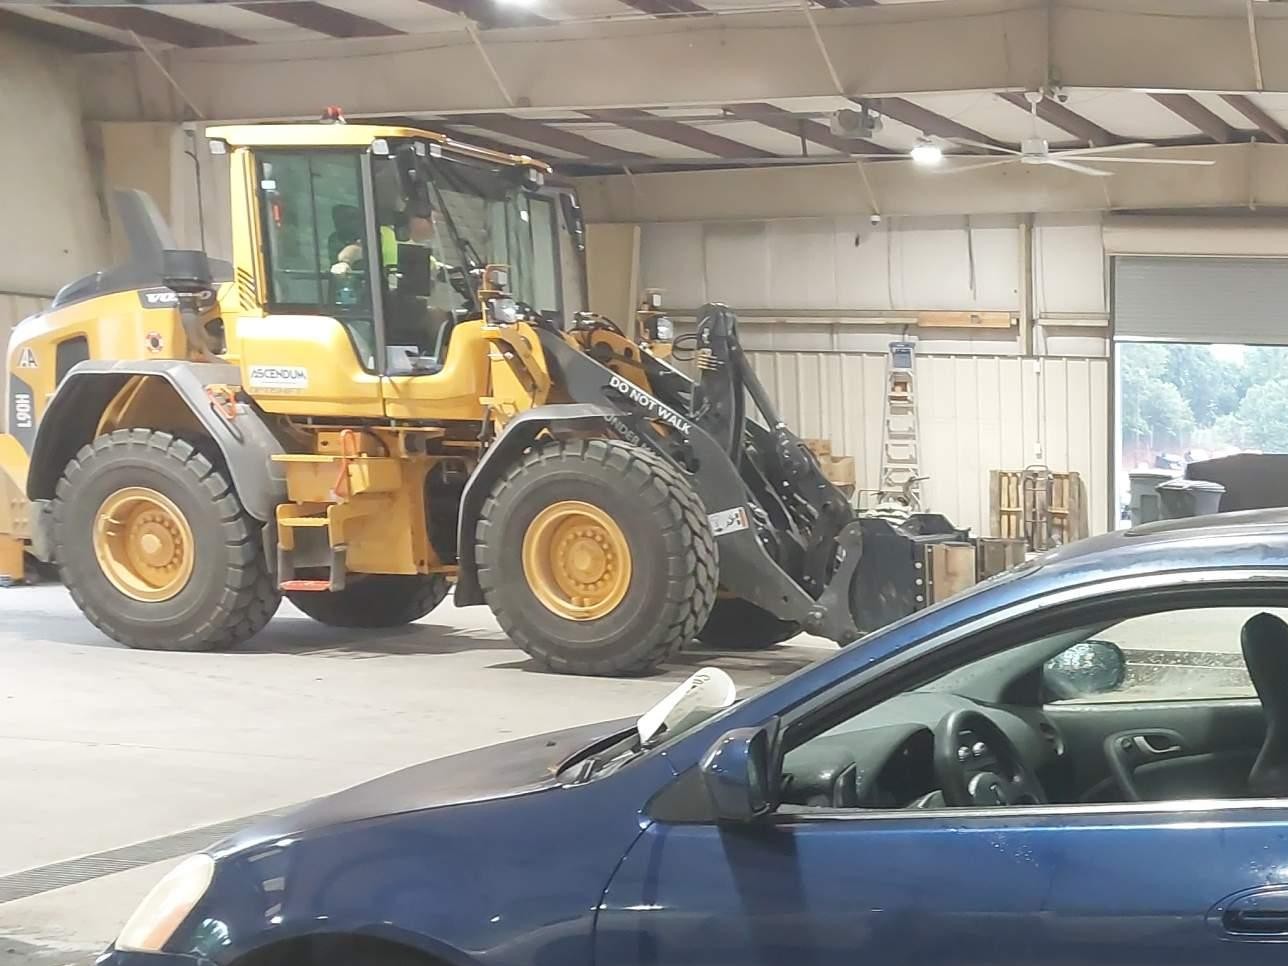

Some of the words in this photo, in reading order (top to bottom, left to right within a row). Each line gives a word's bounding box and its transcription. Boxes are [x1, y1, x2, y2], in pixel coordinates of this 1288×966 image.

[251, 367, 306, 380] ASCENDUM
[15, 393, 32, 428] L90H
[609, 376, 629, 393] DO
[629, 389, 657, 411] NOT
[657, 406, 692, 435] WALK
[603, 415, 640, 446] UNDER
